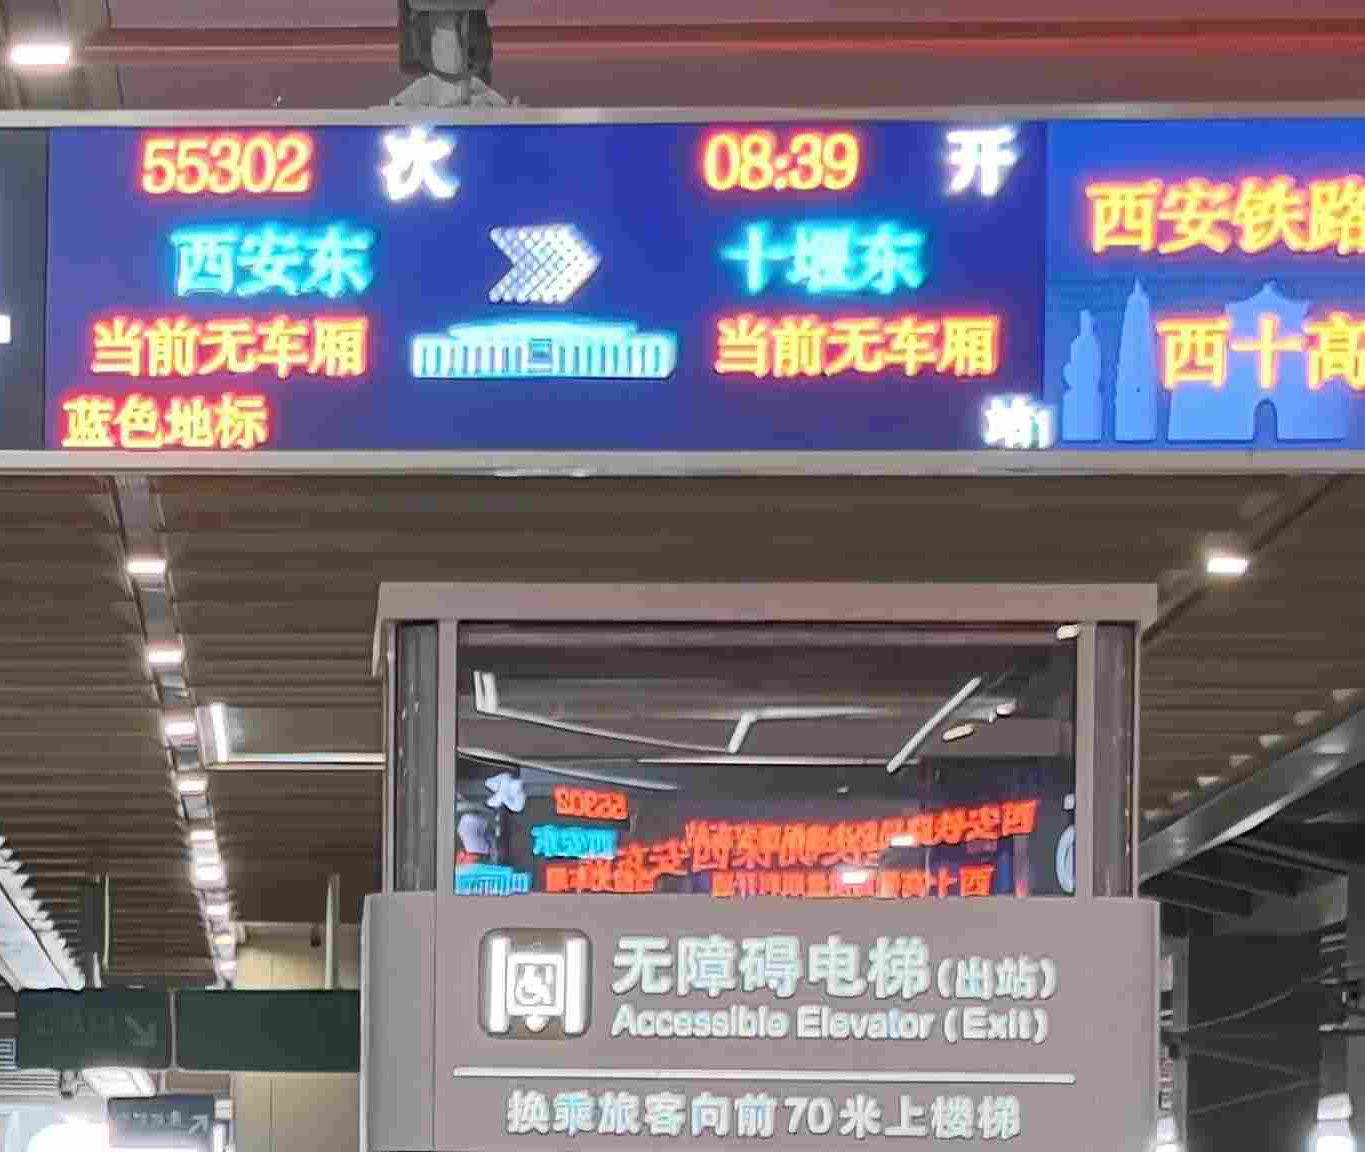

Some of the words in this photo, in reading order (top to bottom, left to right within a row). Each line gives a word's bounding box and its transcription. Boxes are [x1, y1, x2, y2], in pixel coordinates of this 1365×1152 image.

[140, 135, 314, 195] 55302
[382, 126, 461, 201] 次
[703, 132, 860, 193] 08:39
[944, 126, 1020, 197] 开
[1084, 174, 1365, 255] 西安铁路
[171, 223, 373, 295] 西安东
[723, 223, 928, 295] 十堰东
[89, 315, 368, 378] 当前无车厢
[713, 316, 1000, 378] 当前无车厢
[1155, 312, 1365, 391] 西十高
[60, 394, 269, 449] 蓝色地标
[611, 1003, 789, 1039] Accessible
[795, 1005, 935, 1039] Elevator
[944, 1007, 1050, 1043] (Exit)
